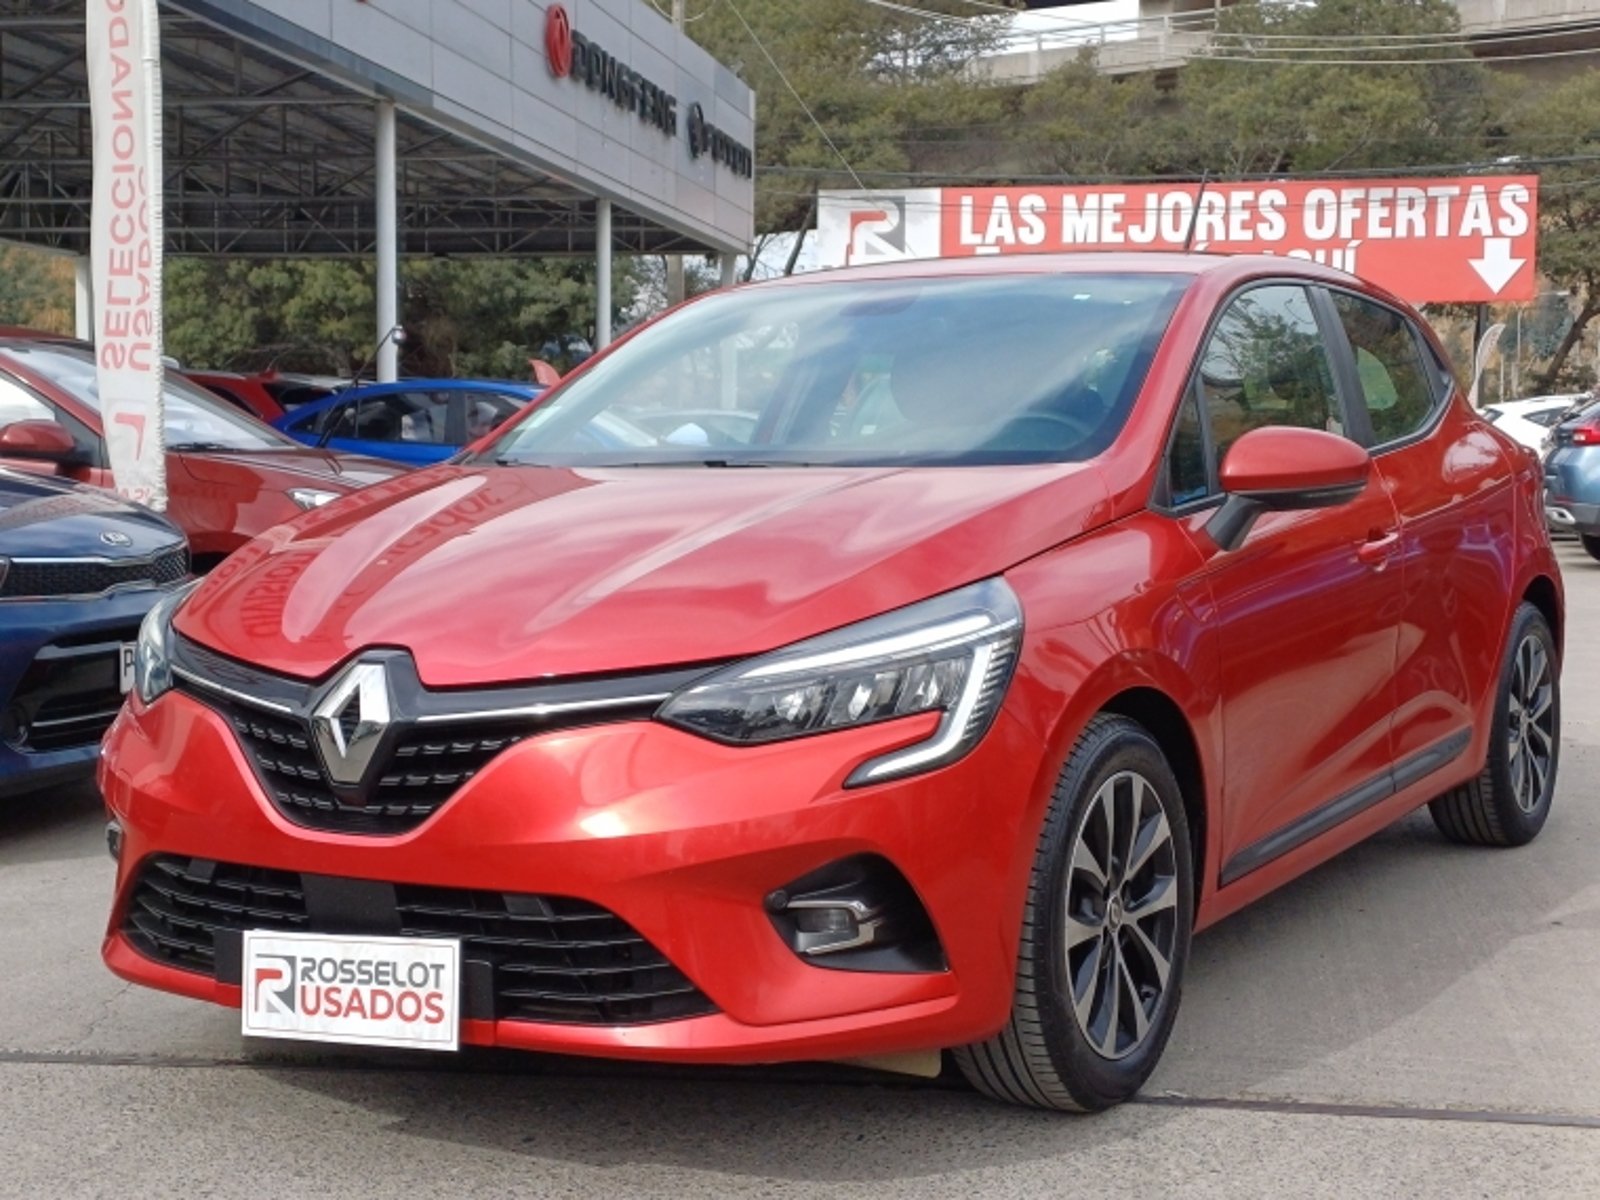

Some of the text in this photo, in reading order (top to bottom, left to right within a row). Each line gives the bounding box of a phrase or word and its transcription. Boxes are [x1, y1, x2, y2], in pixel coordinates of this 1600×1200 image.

[569, 28, 677, 137] DONGFENG
[960, 184, 1530, 245] LAS MEJORES OFERTAS
[301, 957, 446, 988] ROSSELOT
[301, 985, 446, 1024] USADOS
